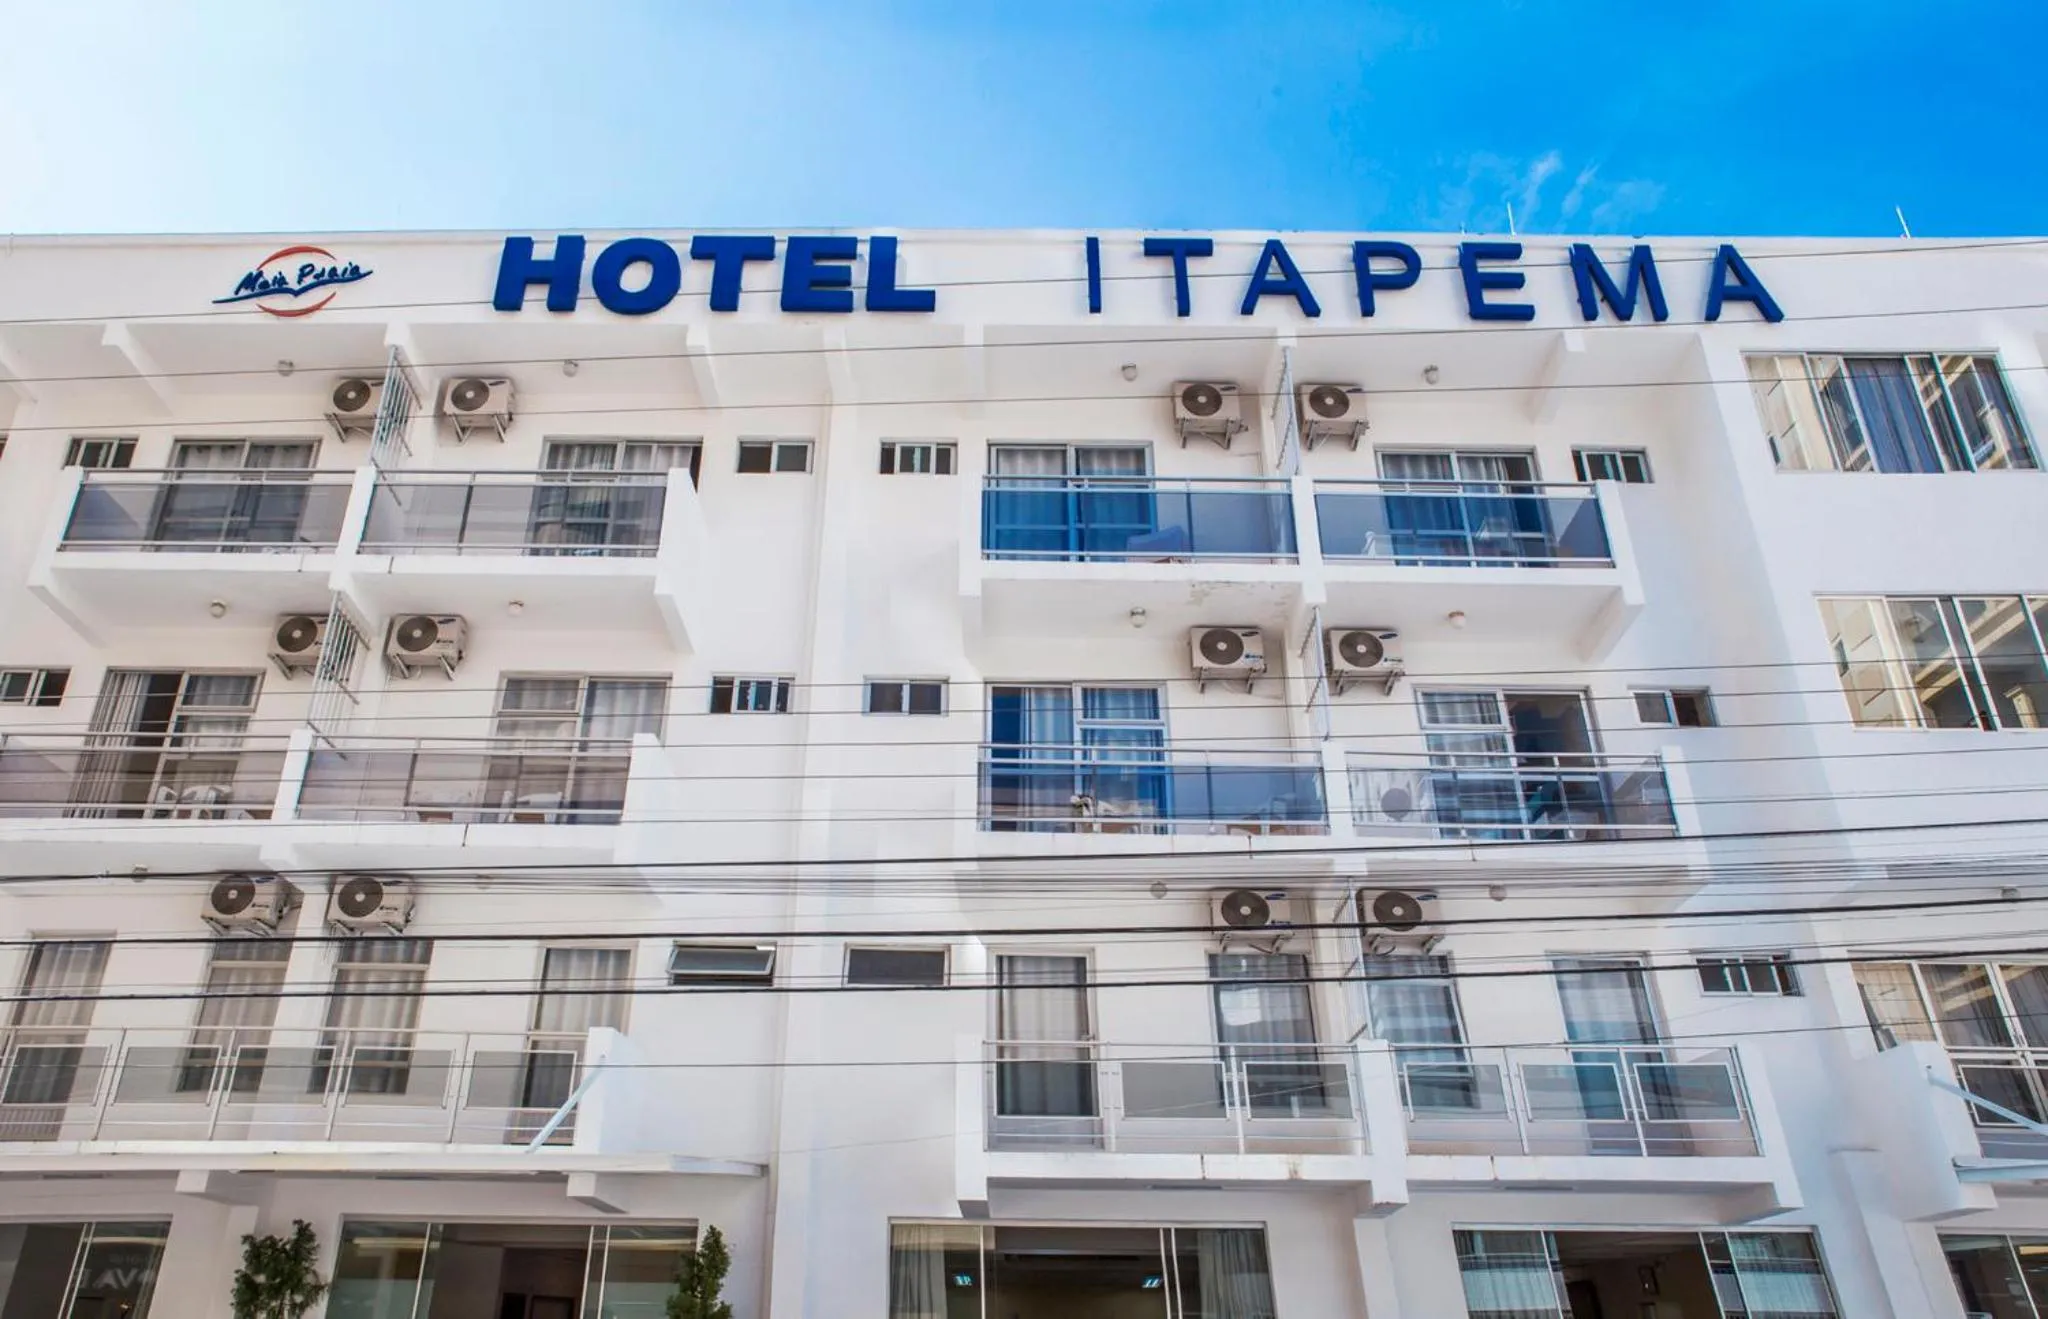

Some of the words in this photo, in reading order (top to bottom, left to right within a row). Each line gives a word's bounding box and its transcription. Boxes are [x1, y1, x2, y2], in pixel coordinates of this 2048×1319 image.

[297, 262, 363, 285] Praia
[493, 235, 937, 313] HOTEL
[1086, 237, 1785, 323] ITAPEMA
